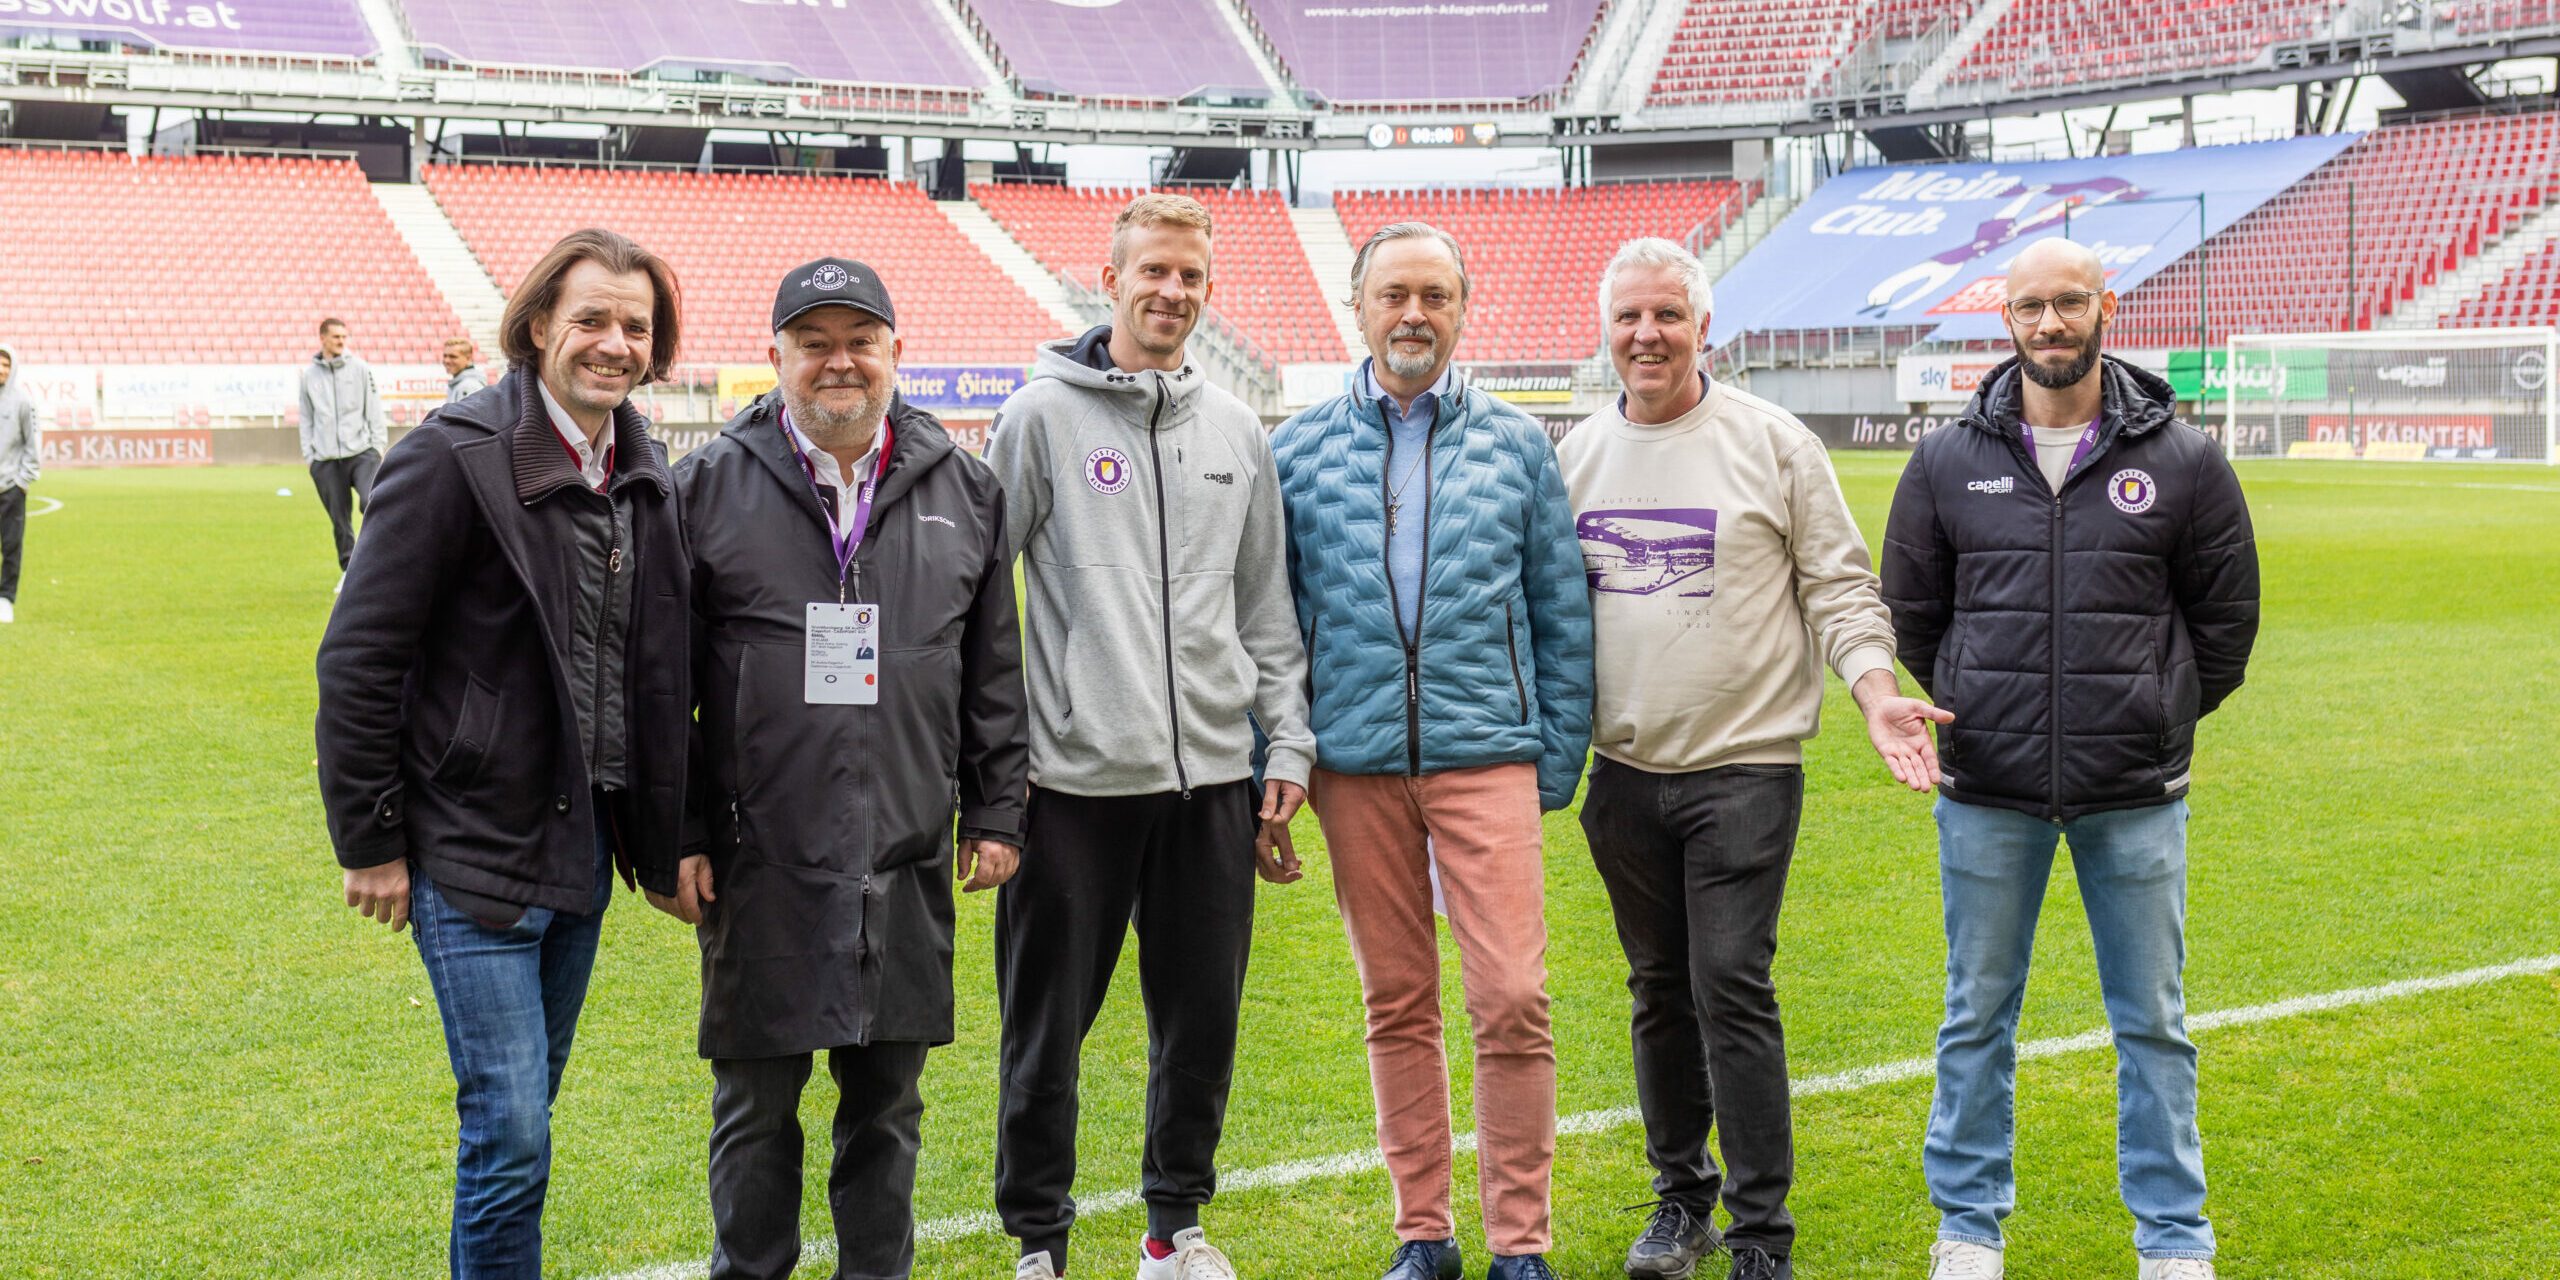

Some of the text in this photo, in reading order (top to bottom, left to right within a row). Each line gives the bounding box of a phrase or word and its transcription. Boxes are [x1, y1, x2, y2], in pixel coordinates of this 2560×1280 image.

[1303, 2, 1549, 18] www.sportpark-klagenfurt.at
[1857, 170, 2022, 202] Mein
[849, 275, 861, 284] 20
[1474, 377, 1571, 391] PROMOTION
[1920, 366, 1985, 389] sky spo
[1852, 416, 1898, 443] Ihre
[2366, 421, 2485, 447] KÄRNTEN
[43, 436, 207, 460] AS KÄRNTEN
[1090, 450, 1125, 464] AUSTRIA
[1203, 472, 1233, 483] capelli
[1967, 476, 2014, 493] capelli
[2114, 471, 2151, 486] AUSTRIA
